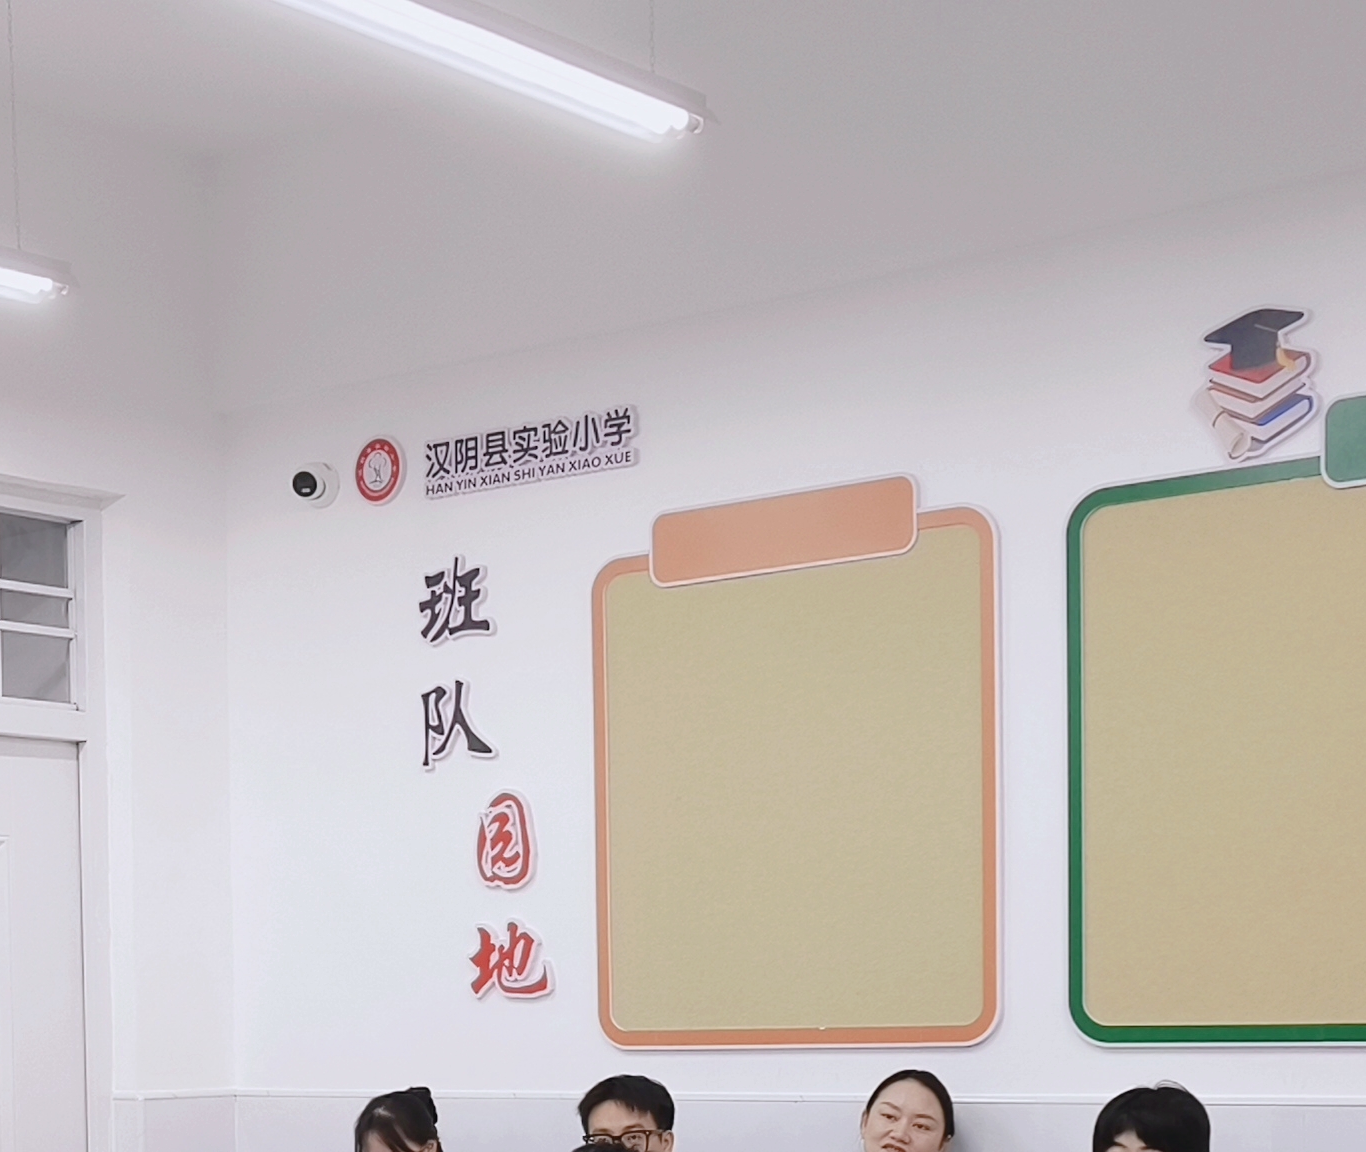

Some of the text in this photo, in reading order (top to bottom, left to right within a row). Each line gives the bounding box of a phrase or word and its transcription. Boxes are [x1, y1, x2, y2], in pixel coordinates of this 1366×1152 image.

[426, 407, 632, 478] 汉阴县实验小学
[426, 451, 632, 496] HAN YIN XIAN SHI YAN XIAO XUE
